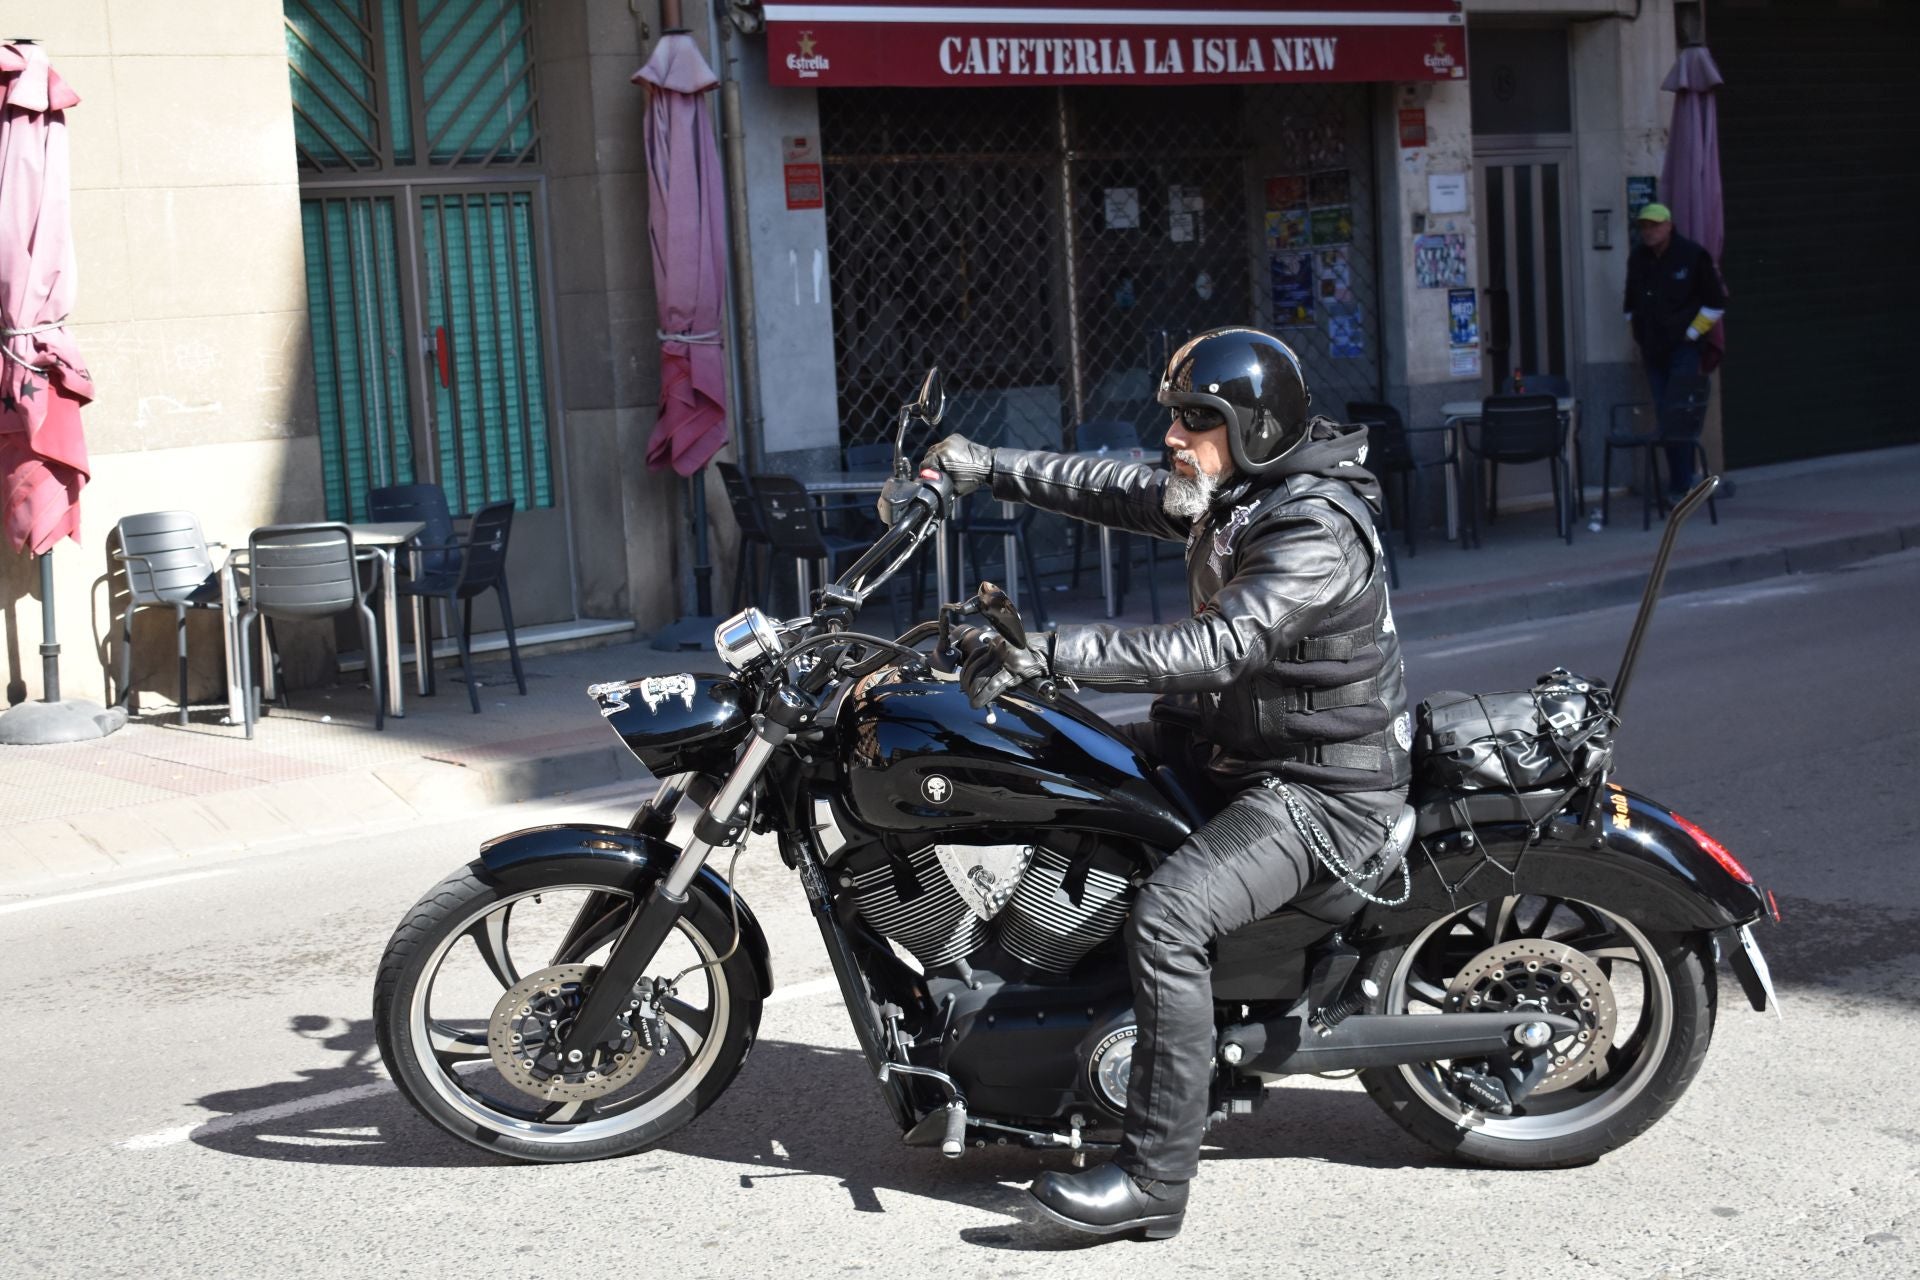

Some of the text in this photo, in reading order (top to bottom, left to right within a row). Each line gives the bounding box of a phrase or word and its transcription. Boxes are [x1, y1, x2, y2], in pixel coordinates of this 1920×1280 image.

[786, 53, 829, 70] Estrella
[939, 36, 1338, 75] CAFETERIA LA ISLA NEW
[641, 1017, 653, 1046] VICTORY
[1469, 1081, 1501, 1104] VICTORY
